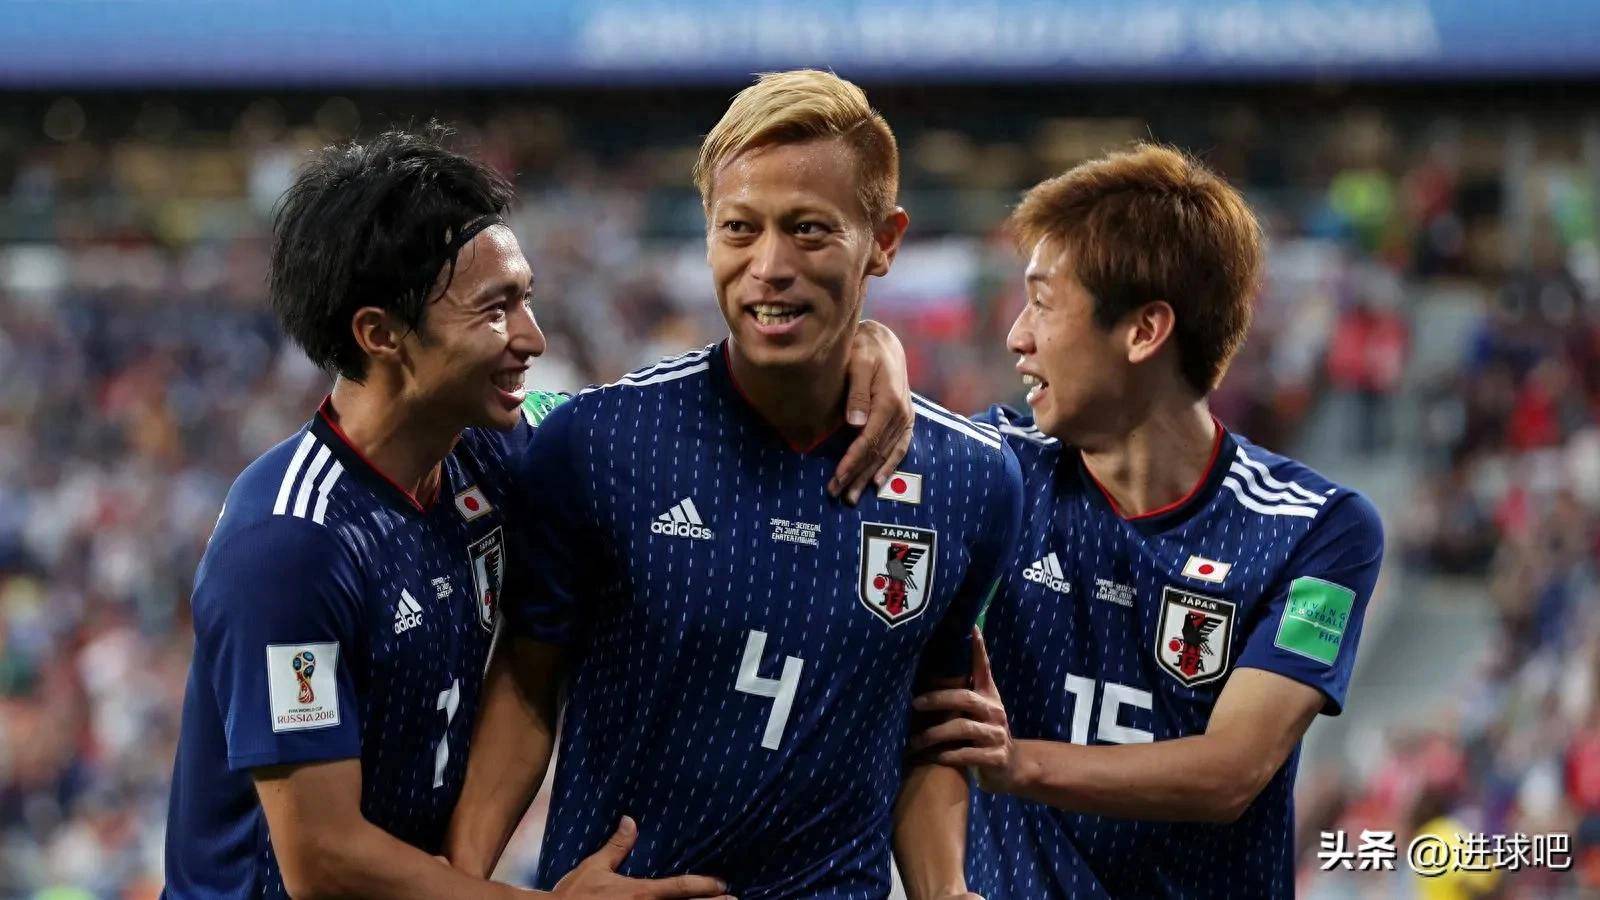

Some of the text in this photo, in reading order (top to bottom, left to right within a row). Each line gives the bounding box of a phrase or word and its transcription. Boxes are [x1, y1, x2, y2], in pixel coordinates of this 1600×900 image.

[651, 521, 712, 540] adidas
[770, 518, 790, 527] JAPAN
[796, 522, 821, 532] SENEGAL
[784, 527, 800, 536] JUNE
[801, 530, 816, 538] 2018
[881, 528, 919, 540] JAPAN
[1022, 567, 1070, 593] adidas
[1180, 595, 1217, 610] JAPAN
[1292, 598, 1346, 619] LIVING
[394, 612, 423, 634] adida
[1290, 606, 1344, 629] FOOTBALL
[1319, 631, 1340, 644] FIFA
[735, 629, 804, 750] 4
[277, 710, 335, 723] RUSSIA 2018
